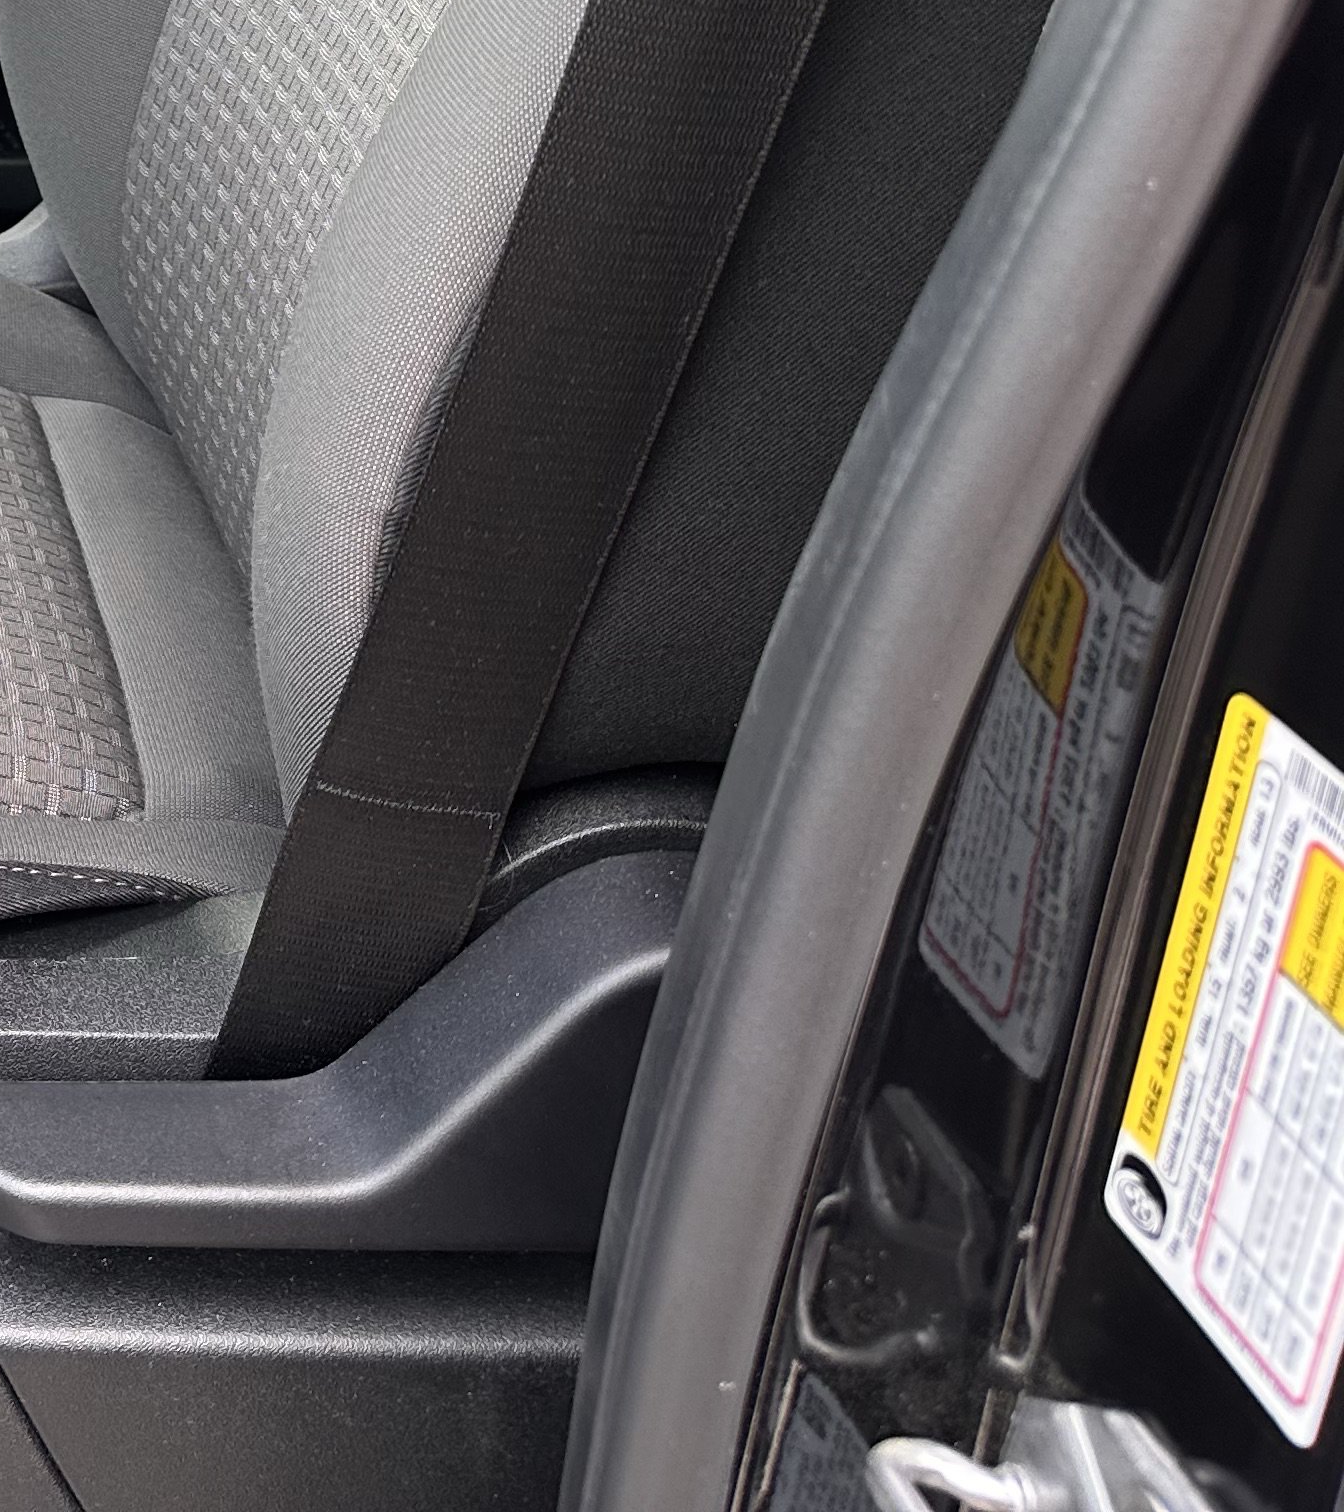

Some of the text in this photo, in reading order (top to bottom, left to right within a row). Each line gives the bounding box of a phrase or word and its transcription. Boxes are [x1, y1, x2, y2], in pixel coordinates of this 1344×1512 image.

[1138, 712, 1257, 1137] TIRE AND LOADING INFORMATION
[1236, 963, 1259, 1017] 1357
[1267, 852, 1290, 907] 2993
